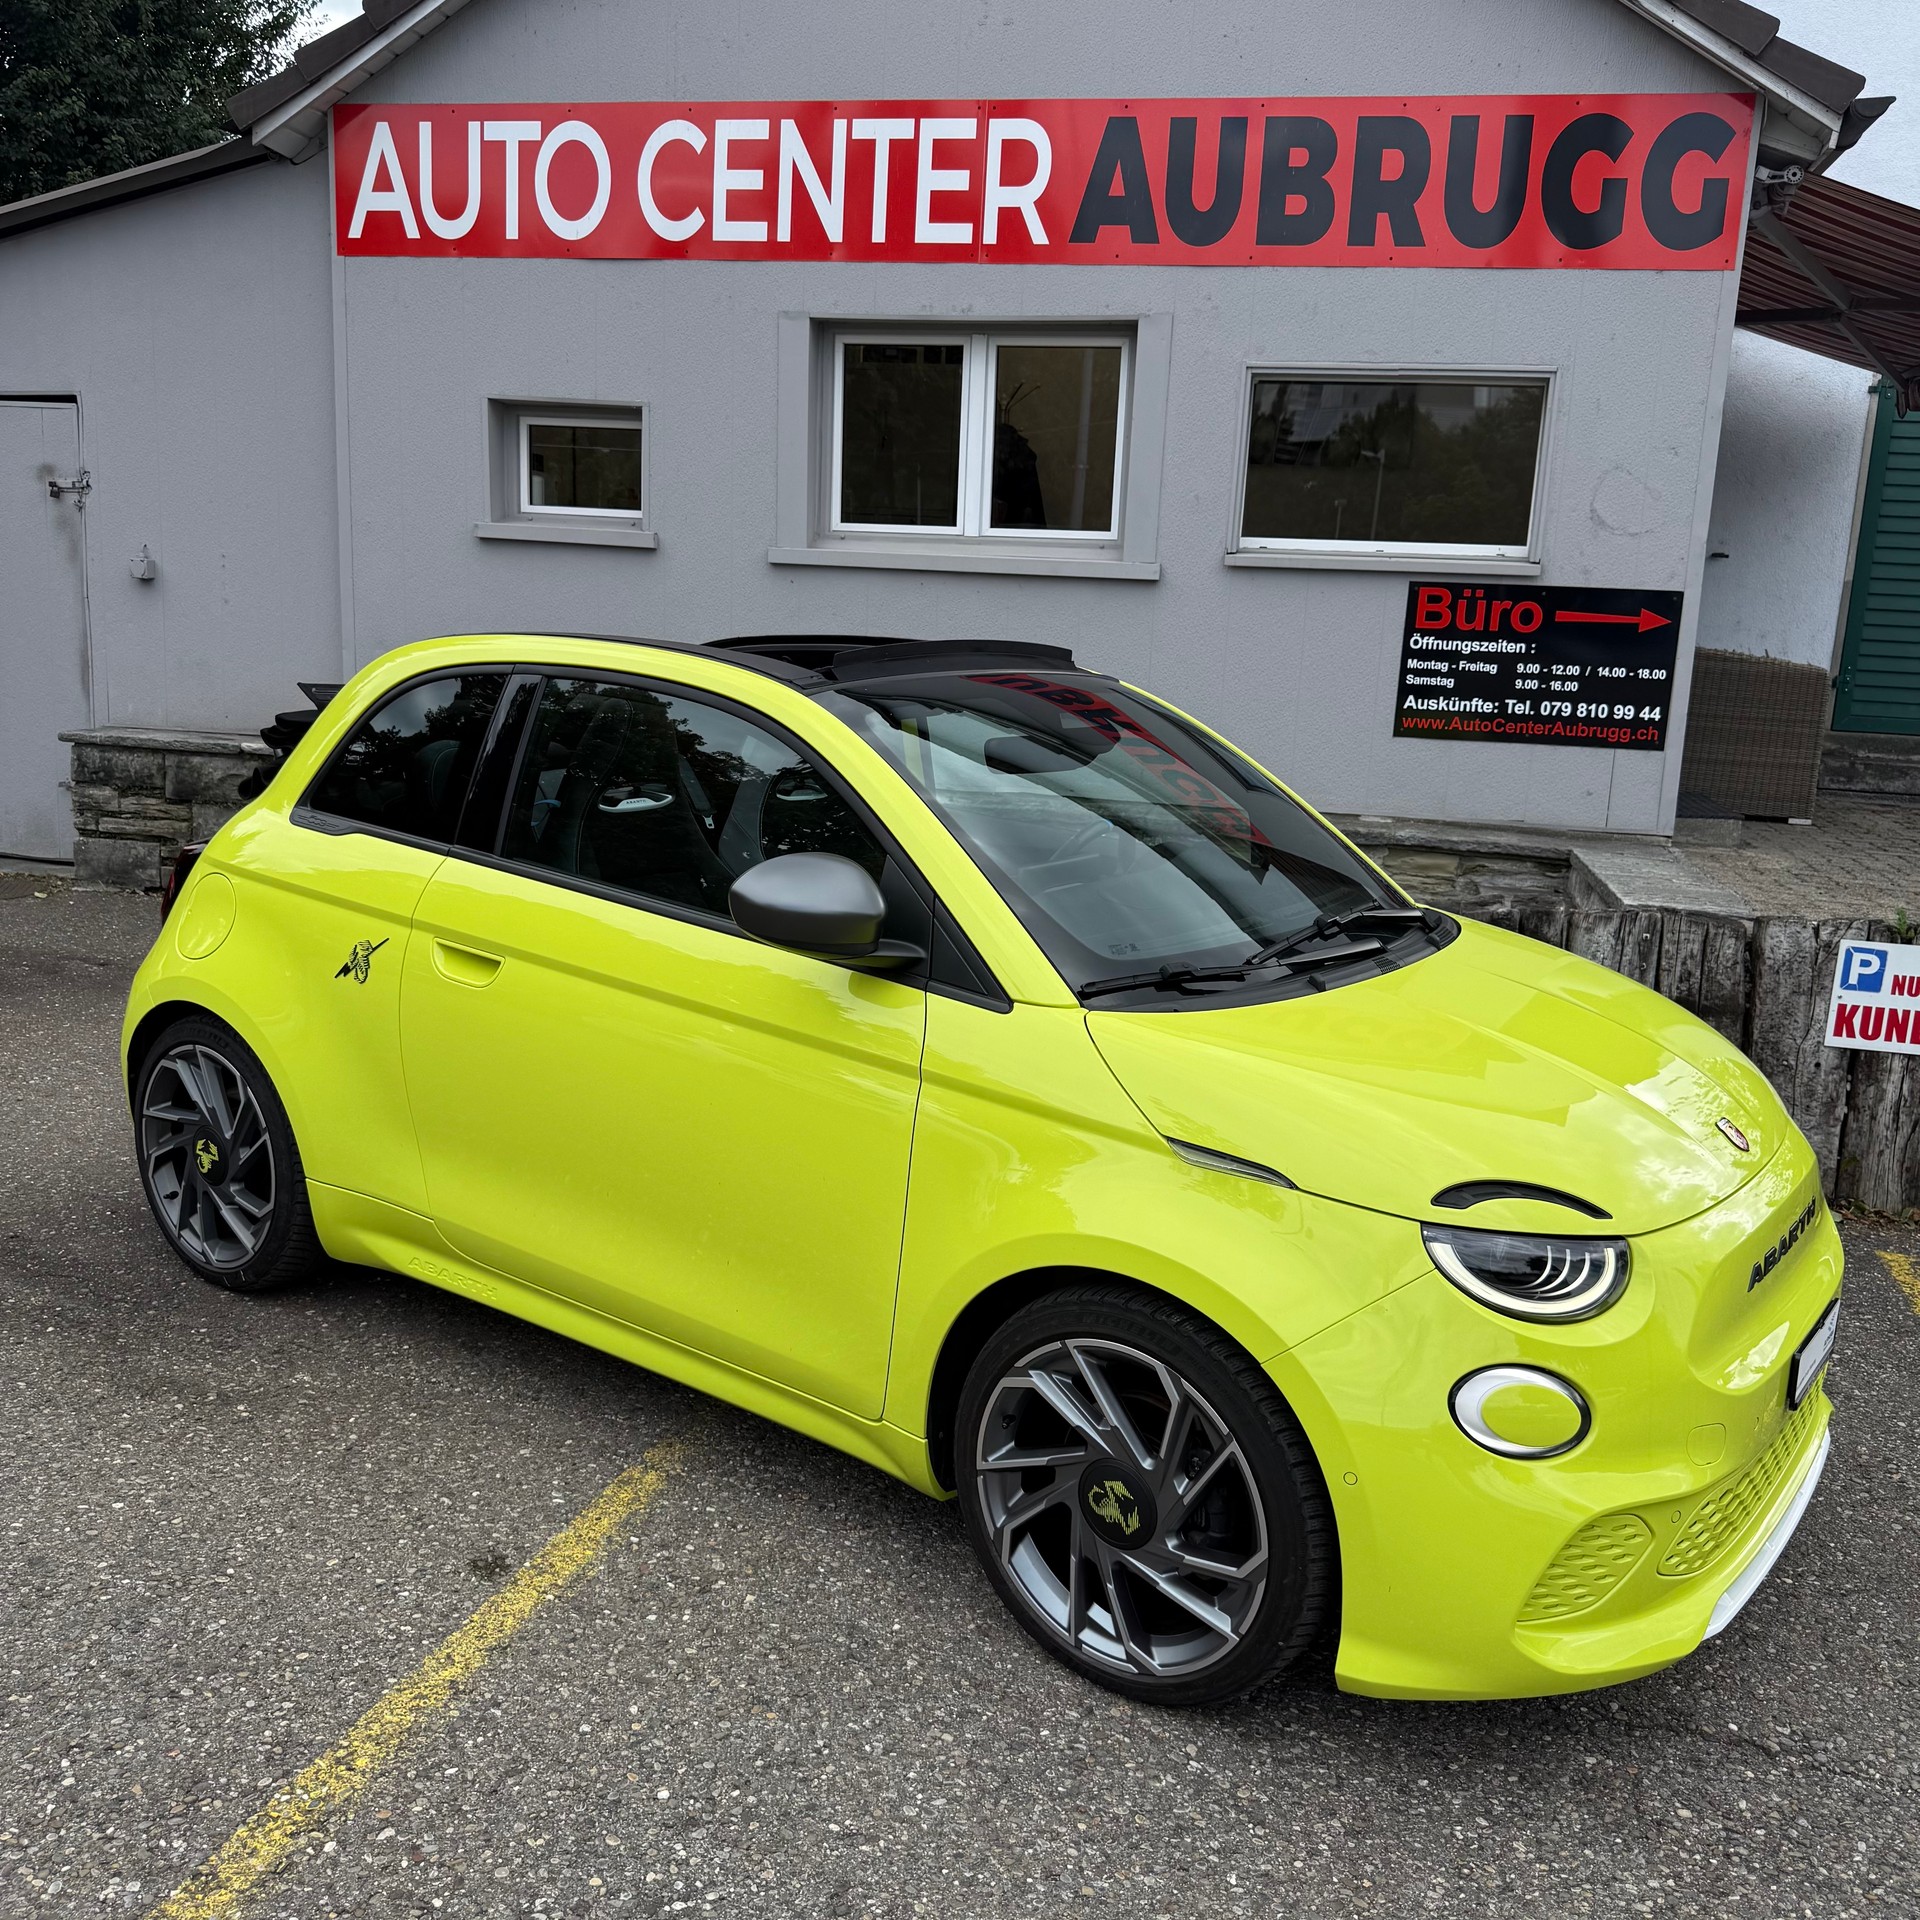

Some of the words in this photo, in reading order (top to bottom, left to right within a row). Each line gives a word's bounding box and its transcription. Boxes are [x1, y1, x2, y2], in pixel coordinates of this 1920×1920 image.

[347, 119, 612, 241] AUTO
[636, 117, 1053, 245] CENTER
[1067, 111, 1738, 252] AUBRUGG
[1414, 586, 1544, 633] Büro
[1409, 633, 1526, 654] Öffnungszeiten
[1405, 674, 1455, 689] Samstag
[1514, 678, 1538, 690] 9.00
[1549, 680, 1579, 692] 16.00
[1406, 658, 1449, 673] Montag
[1458, 660, 1498, 675] Freitag
[1516, 662, 1540, 674] 9.00
[1550, 664, 1580, 676] 12.00
[1596, 666, 1626, 678] 14.00
[1636, 668, 1667, 680] 18.00
[1403, 694, 1500, 714] Auskünfte:
[1505, 699, 1535, 715] Tel.
[1540, 701, 1572, 717] 079
[1576, 702, 1609, 719] 810
[1612, 704, 1635, 720] 99
[1638, 705, 1662, 722] 44
[1402, 715, 1659, 743] www.AutoCenterAubrugg.ch
[1746, 1195, 1817, 1293] ABARTH
[407, 1256, 498, 1301] ABARTH
